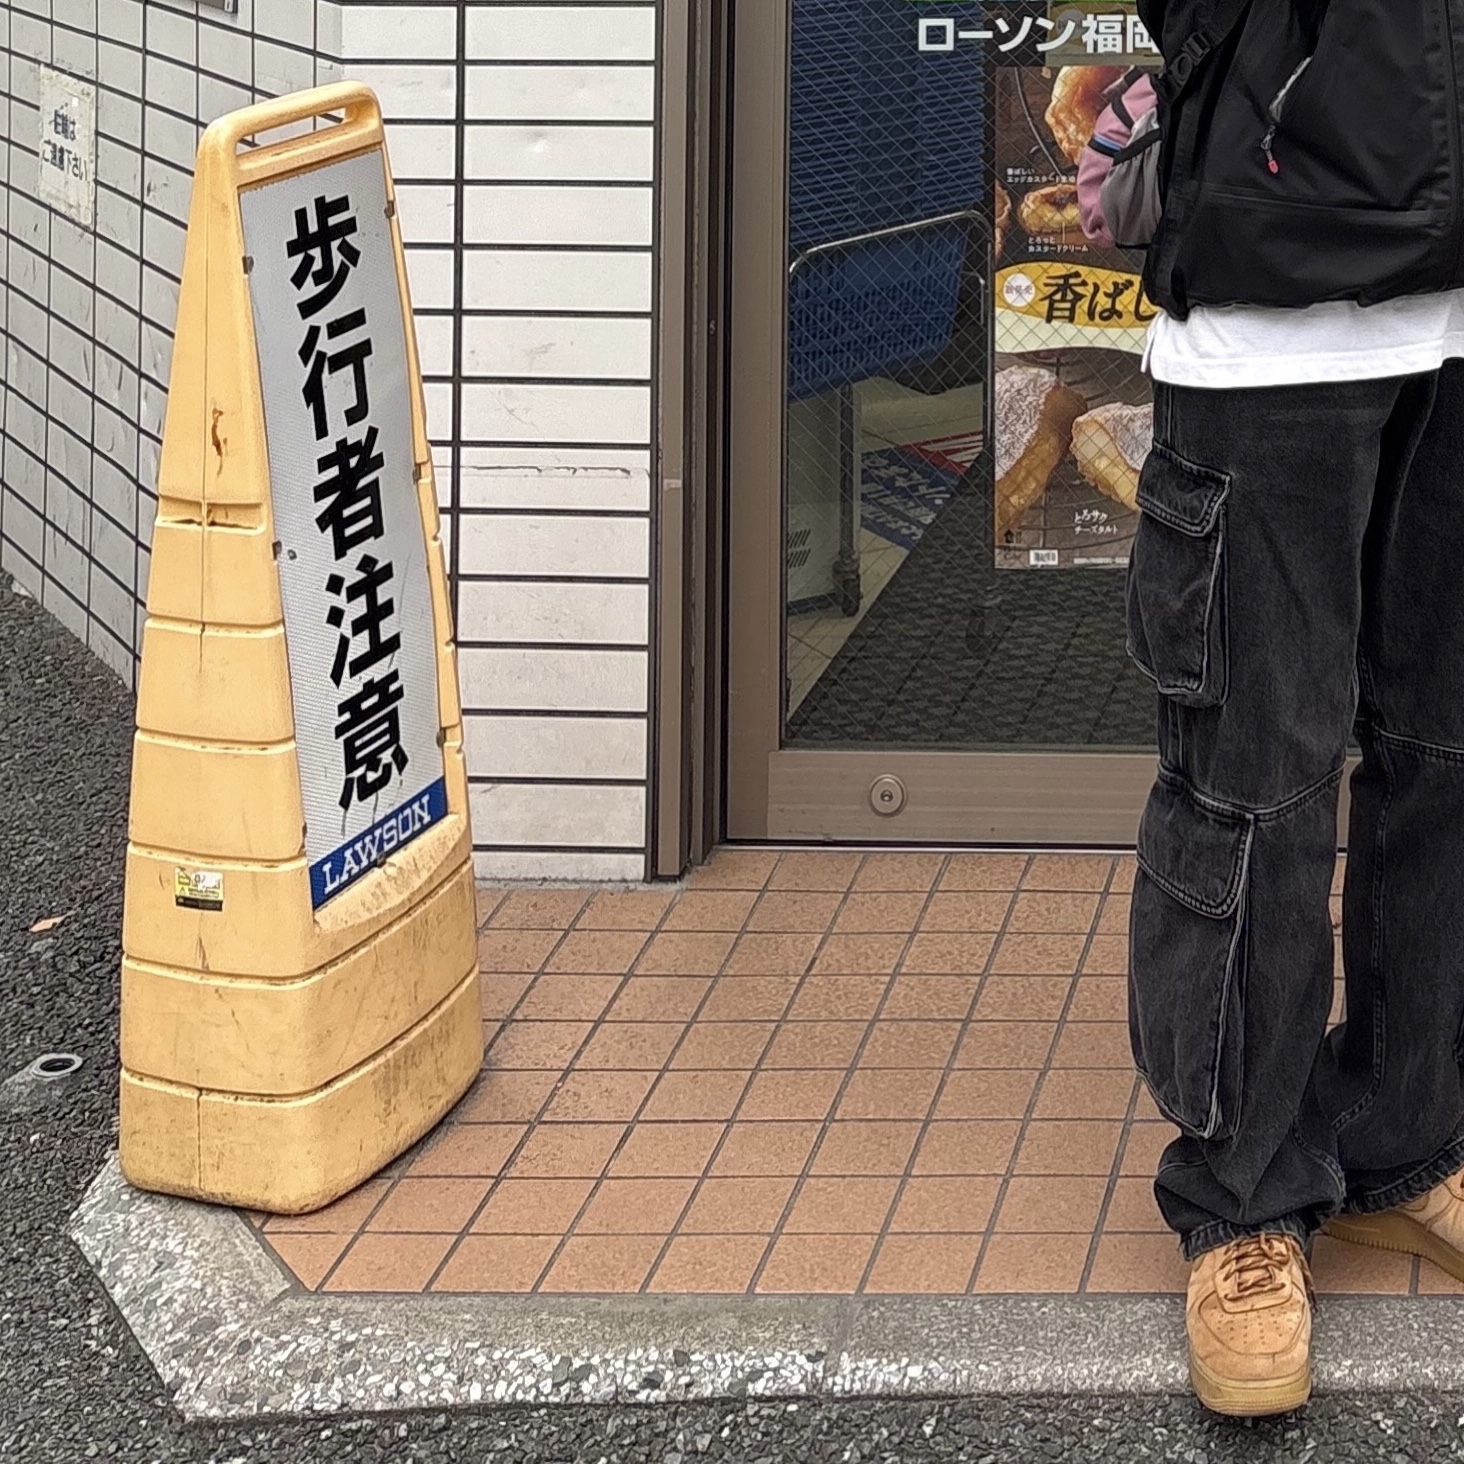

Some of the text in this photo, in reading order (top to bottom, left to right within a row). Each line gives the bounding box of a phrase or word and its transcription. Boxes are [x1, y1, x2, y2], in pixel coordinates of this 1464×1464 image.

[918, 14, 1163, 54] ローソン福岡
[287, 193, 407, 813] 歩行者注意
[323, 792, 432, 899] LAWSON
